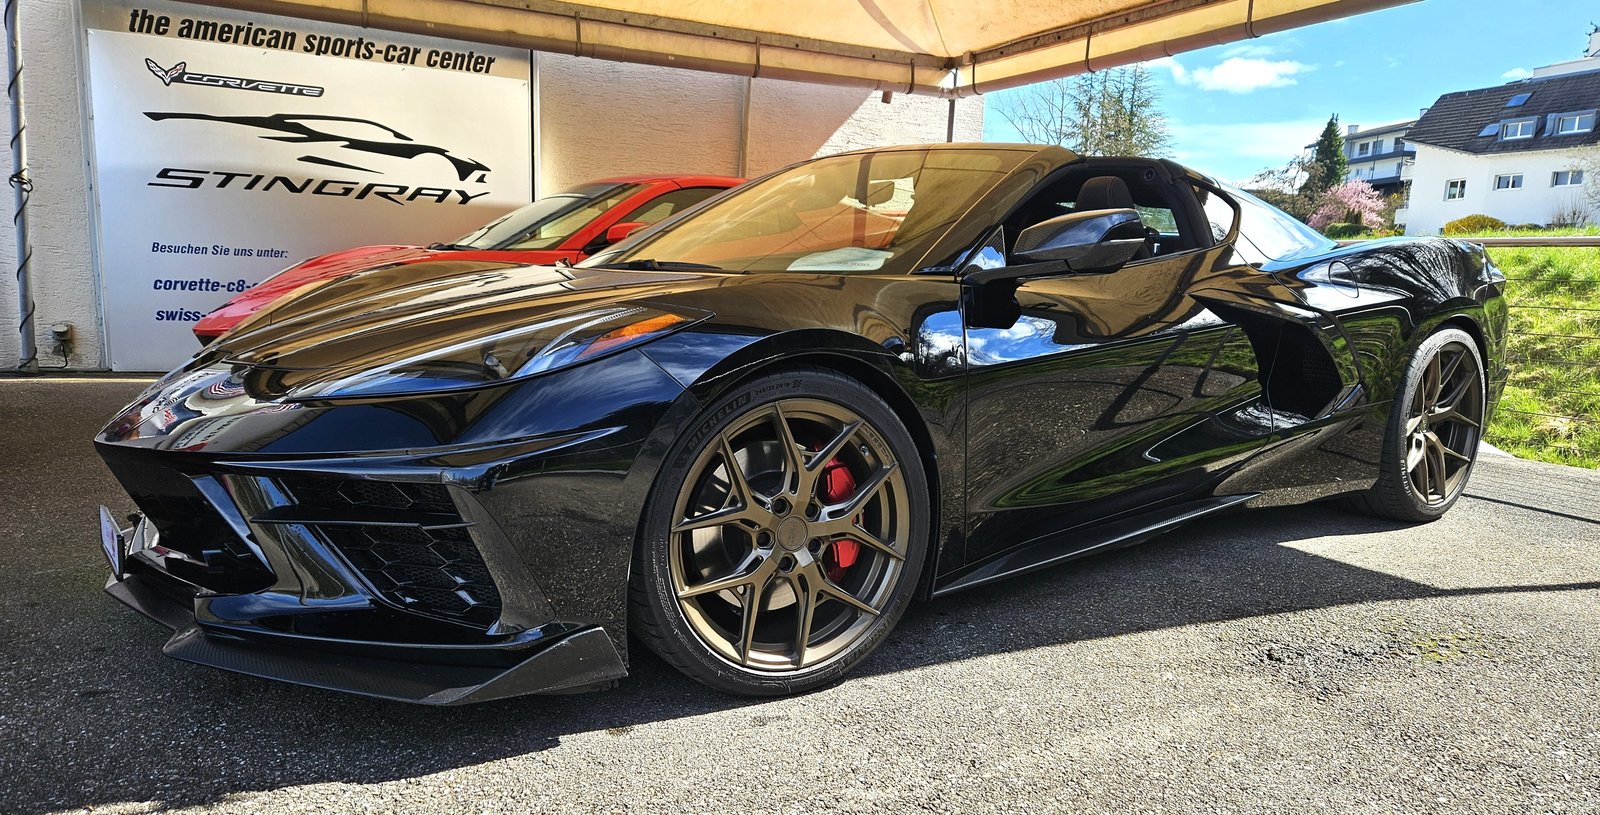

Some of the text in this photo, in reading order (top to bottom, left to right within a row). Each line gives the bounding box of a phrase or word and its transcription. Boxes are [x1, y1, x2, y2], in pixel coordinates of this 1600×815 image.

[130, 9, 496, 73] the american sports-car center
[182, 73, 323, 97] CORVETTE
[147, 167, 490, 206] STINGRAY
[151, 242, 289, 259] Besuchen Sie uns unter:
[155, 308, 212, 322] swiss-
[687, 393, 749, 447] MICHELIN
